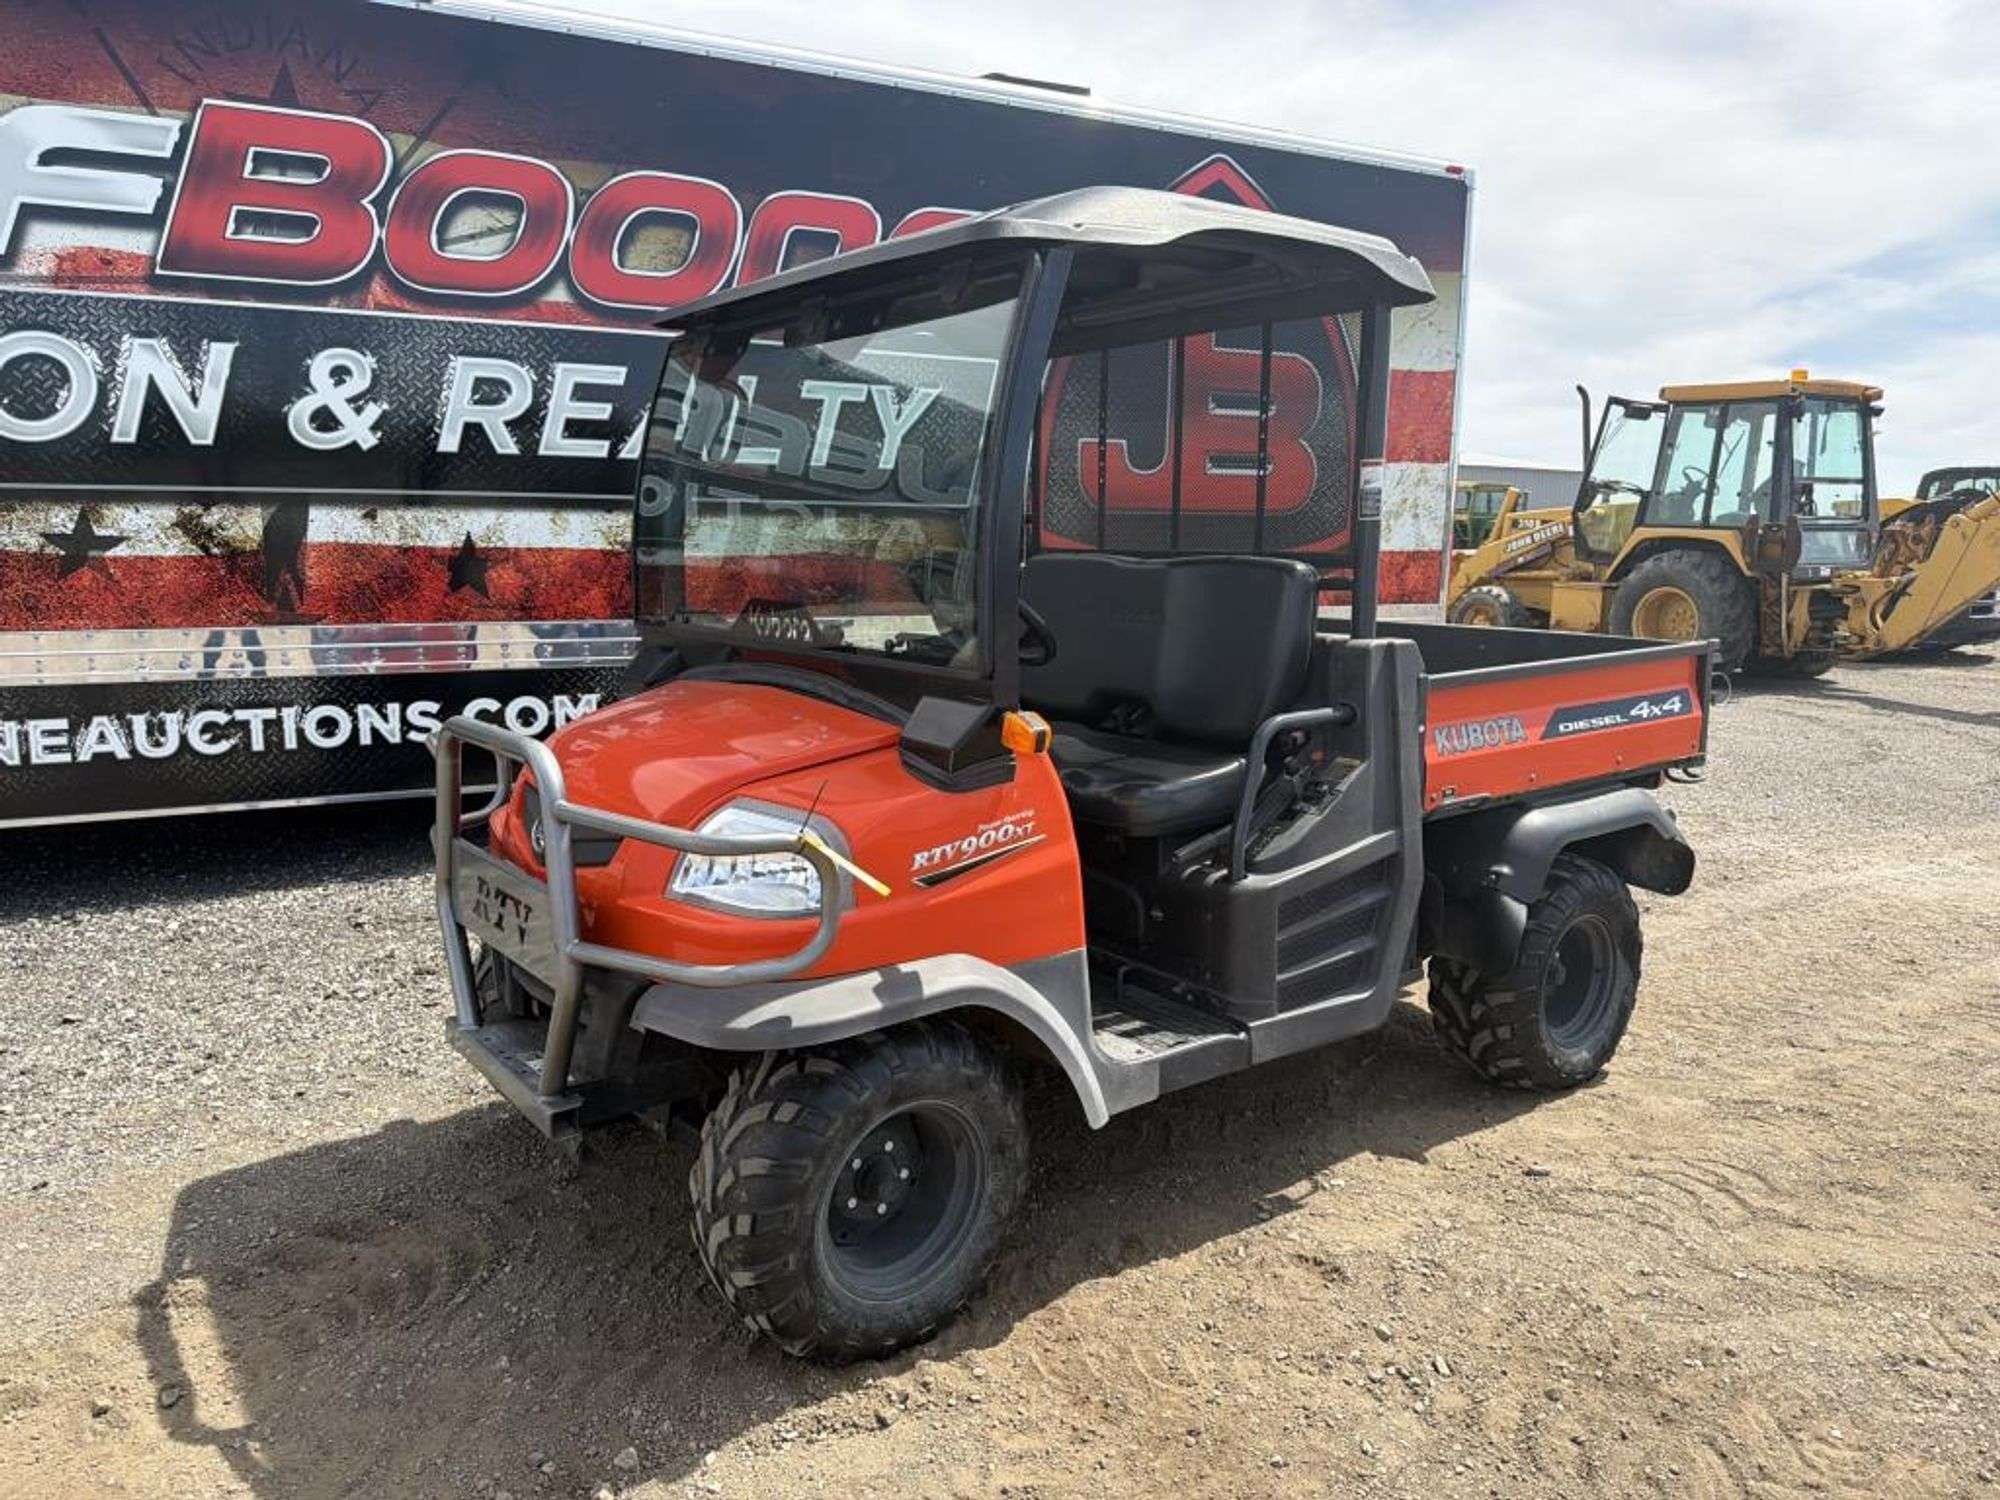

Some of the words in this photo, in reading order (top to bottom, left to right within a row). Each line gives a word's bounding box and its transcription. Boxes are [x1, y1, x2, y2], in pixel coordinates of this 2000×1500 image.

[287, 347, 384, 451] &
[1434, 714, 1528, 757] KUBOTA
[1558, 713, 1629, 733] DIESEL
[1629, 696, 1683, 720] 4x4
[473, 875, 533, 946] RTV
